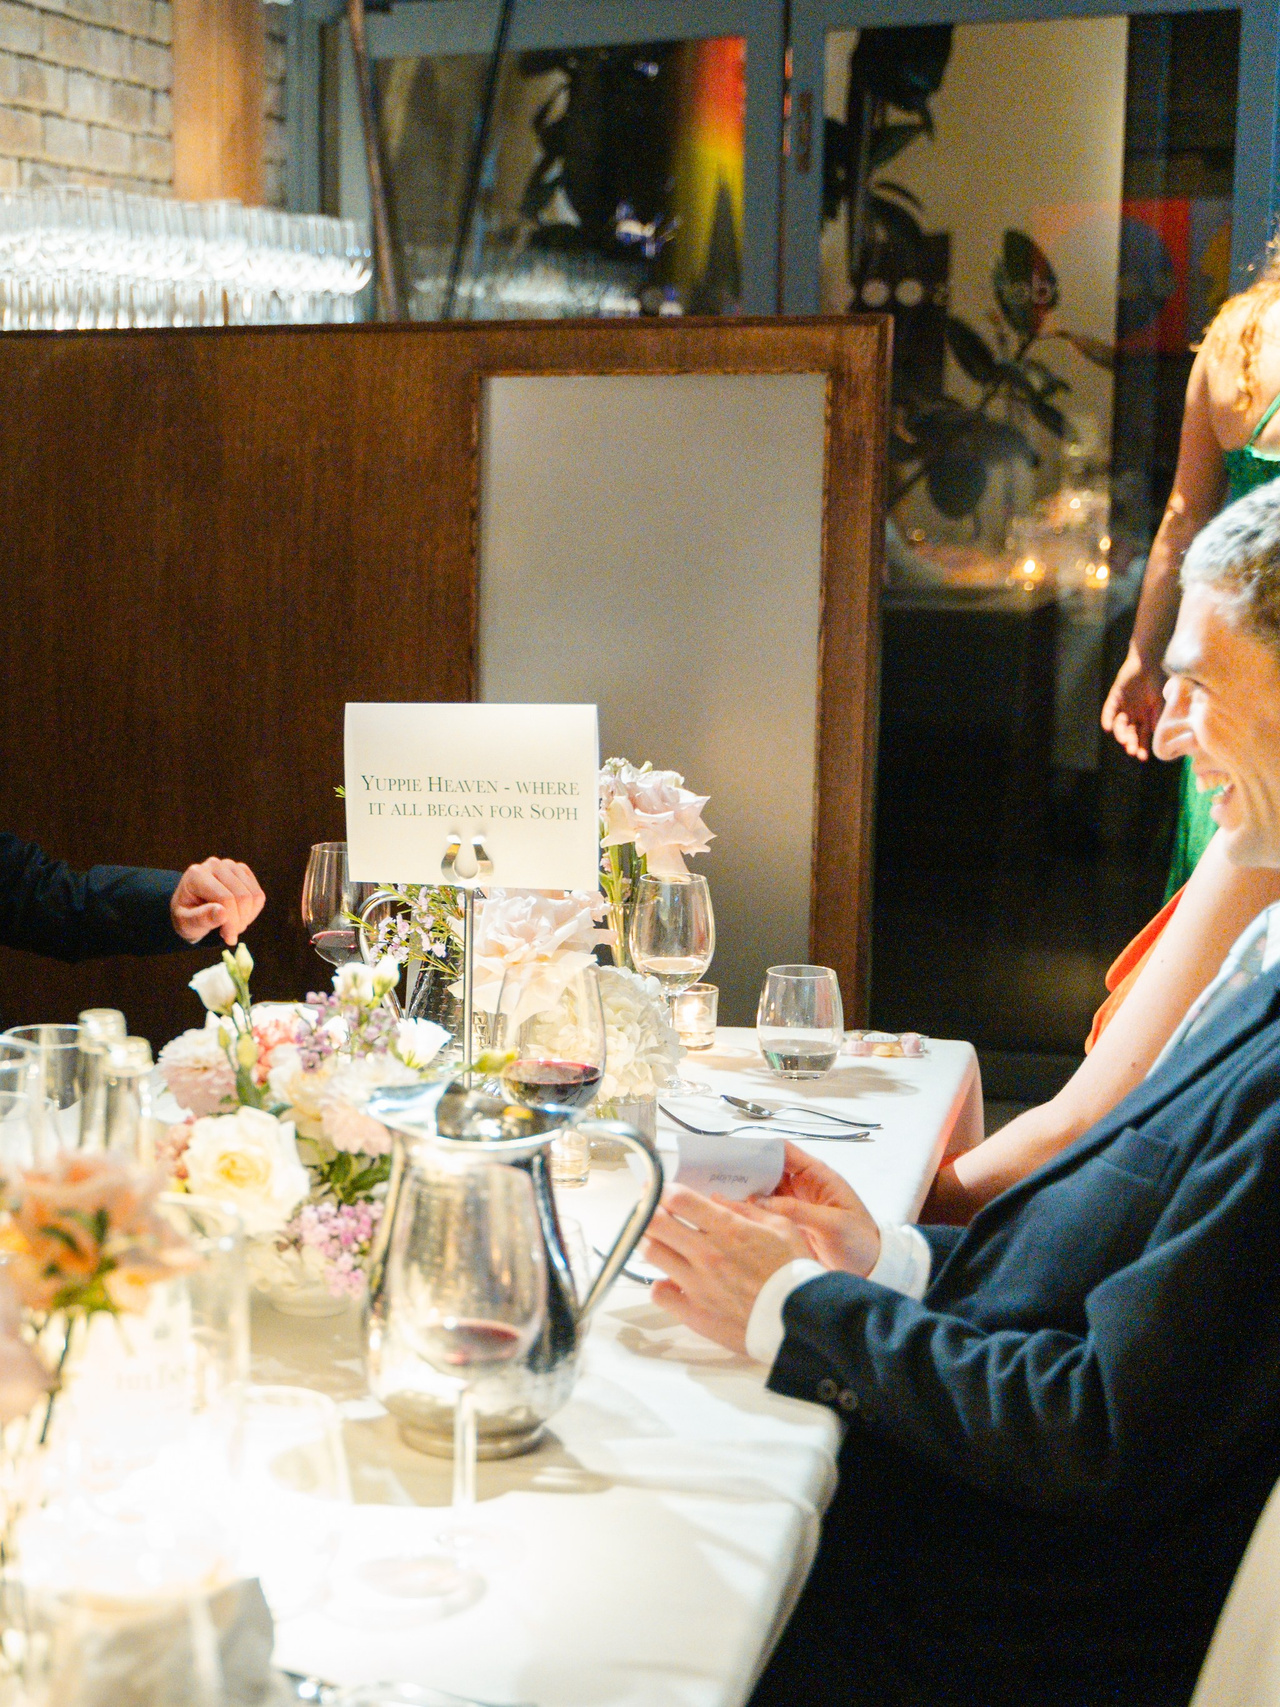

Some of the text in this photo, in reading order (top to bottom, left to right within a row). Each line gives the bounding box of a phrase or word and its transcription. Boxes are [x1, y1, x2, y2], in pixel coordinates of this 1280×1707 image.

[361, 775, 422, 792] YUPPIE
[428, 776, 498, 794] HEAVEN
[516, 780, 580, 796] WHERE
[369, 802, 578, 821] IT ALL BEGAN FOR SOPH
